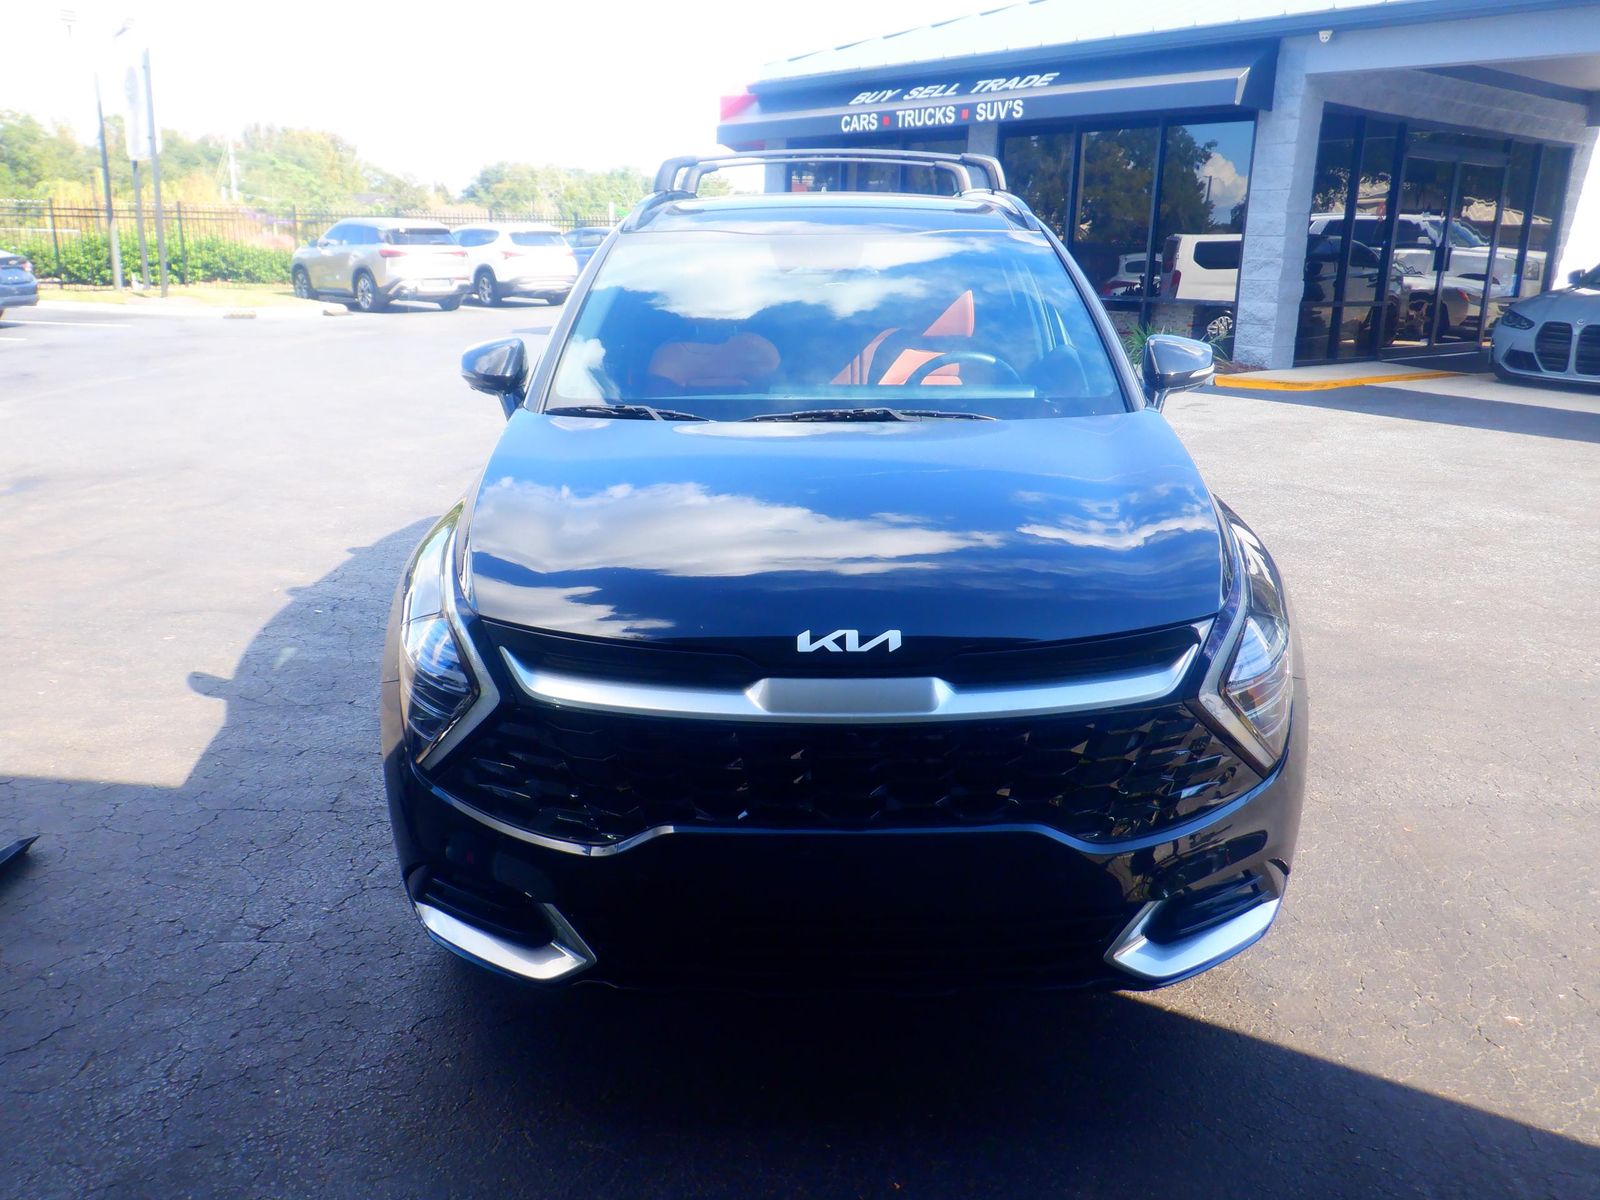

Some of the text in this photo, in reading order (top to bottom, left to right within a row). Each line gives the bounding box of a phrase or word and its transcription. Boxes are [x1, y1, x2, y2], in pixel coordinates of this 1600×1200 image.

[849, 72, 1060, 105] BUY SELL TRADE
[841, 100, 1024, 132] CARS TRUCKS SUV'S
[797, 629, 902, 652] KIA
